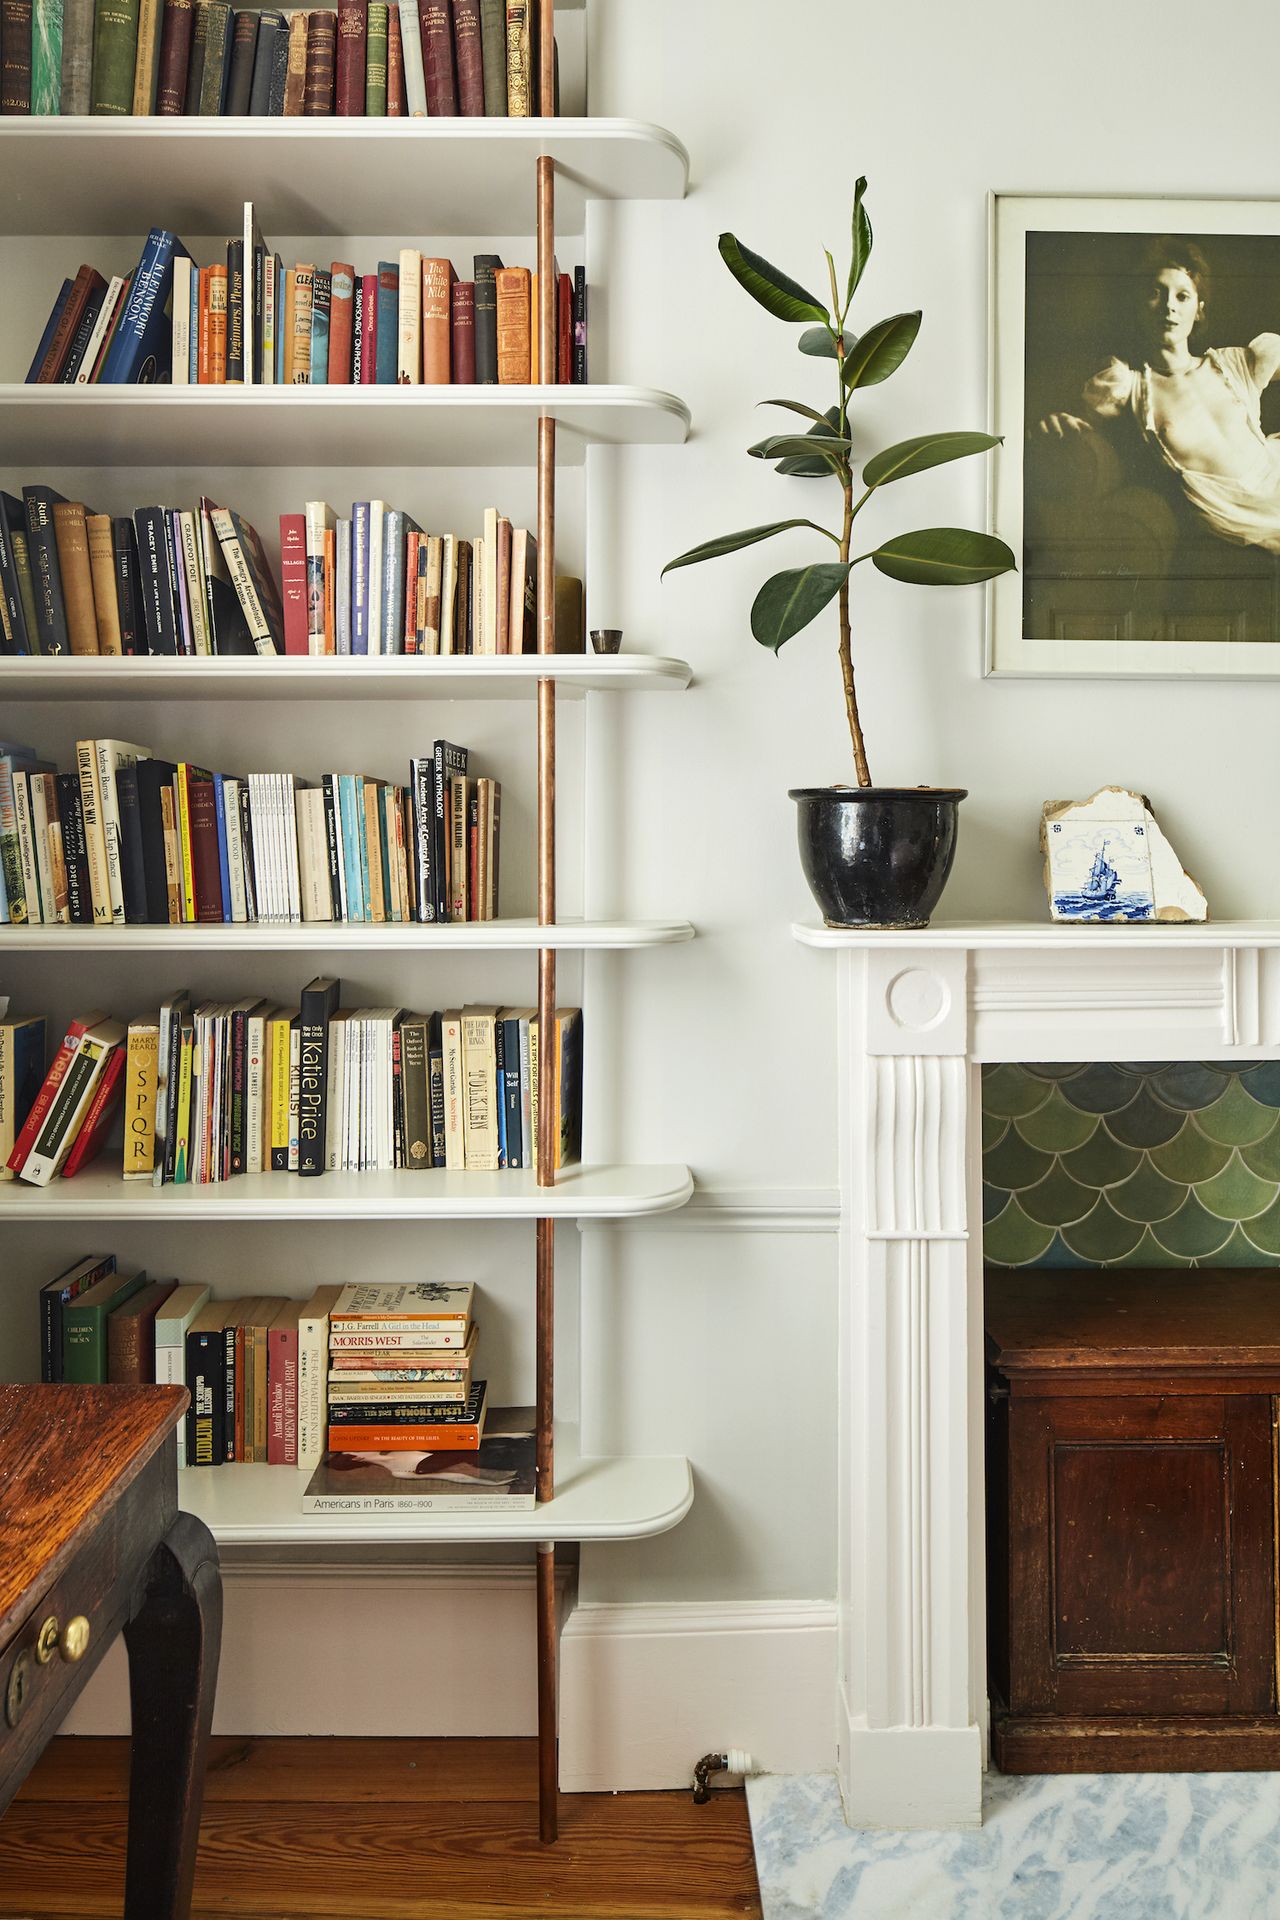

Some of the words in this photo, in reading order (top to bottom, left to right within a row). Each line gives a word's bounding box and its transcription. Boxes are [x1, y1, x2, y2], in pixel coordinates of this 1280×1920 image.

[428, 262, 444, 274] The
[230, 271, 242, 304] Please
[424, 274, 448, 287] White
[128, 271, 151, 323] BENSON
[134, 263, 165, 339] KLEINWORT
[355, 288, 363, 309] SUSAN
[427, 286, 446, 299] Nile
[229, 305, 242, 361] Beginners,
[355, 309, 363, 335] SONTAG
[354, 338, 362, 350] ON
[27, 496, 40, 533] Rendell
[38, 502, 47, 526] Ruth
[146, 520, 155, 551] TRACEY
[153, 579, 158, 587] MY
[183, 523, 194, 562] CRACKPOT
[231, 546, 241, 559] The
[37, 553, 49, 572] Sight
[120, 555, 128, 577] TERRY
[188, 563, 196, 583] POET
[234, 559, 249, 584] Hungry
[42, 574, 50, 587] For
[43, 589, 52, 606] Sore
[234, 581, 247, 606] France
[44, 608, 54, 625] Eyes
[191, 597, 201, 623] JEREMY
[243, 583, 265, 628] Archaeologist
[194, 624, 204, 647] SIGLER
[77, 746, 91, 769] LOOK
[97, 745, 109, 774] Andrew
[434, 746, 442, 771] GREEK
[80, 769, 92, 779] AT
[82, 780, 93, 788] IT
[82, 789, 96, 807] THIS
[100, 775, 112, 800] Barrow
[227, 785, 235, 811] UNDER
[419, 776, 428, 804] Ancient
[435, 773, 443, 818] MYTHOLOGY
[453, 783, 462, 811] MAKING
[84, 808, 97, 825] WAY
[420, 807, 428, 822] Arts
[105, 819, 115, 836] The
[420, 824, 429, 833] of
[454, 821, 463, 847] KILLING
[21, 835, 31, 867] intelligent
[78, 833, 86, 855] Robert
[105, 836, 117, 851] Tap
[421, 833, 429, 861] Central
[69, 864, 79, 887] place
[108, 852, 119, 878] Dancer
[422, 862, 430, 878] Asia
[71, 890, 79, 908] safe
[311, 1025, 324, 1033] Only
[464, 1021, 475, 1029] THE
[467, 1029, 474, 1037] OF
[475, 1029, 486, 1037] THE
[449, 1048, 456, 1057] My
[468, 1037, 485, 1046] RINGS
[47, 1050, 73, 1088] heat
[78, 1059, 89, 1074] DEATH
[302, 1042, 323, 1089] Katie
[449, 1056, 457, 1075] Secret
[69, 1079, 79, 1096] CREDIT
[291, 1064, 300, 1092] KILL
[506, 1079, 519, 1087] Self
[522, 1069, 530, 1090] carver
[38, 1095, 48, 1107] Bill
[290, 1092, 300, 1116] LIST
[469, 1069, 489, 1131] TOLKIEN
[27, 1106, 44, 1131] Buford
[301, 1094, 322, 1140] Price
[449, 1114, 457, 1132] Friday
[341, 1323, 356, 1331] J.G.
[357, 1322, 379, 1330] Farrell
[388, 1322, 402, 1330] Girl
[402, 1322, 408, 1330] in
[408, 1322, 421, 1330] the
[422, 1322, 440, 1330] Head
[333, 1337, 374, 1347] MORRIS
[374, 1336, 403, 1346] WEST
[226, 1369, 234, 1383] HOLY
[284, 1359, 295, 1386] ARBAT
[196, 1375, 205, 1403] SCORPIO
[310, 1349, 319, 1420] PRE-RAPHAELITES
[204, 1387, 213, 1414] ILLUSION
[226, 1383, 234, 1413] PICTURES
[271, 1382, 283, 1411] Rybakov
[284, 1388, 295, 1405] THE
[196, 1403, 204, 1415] THE
[284, 1407, 295, 1417] OF
[394, 1408, 433, 1417] THOMAS
[434, 1407, 462, 1415] LESLIE
[272, 1412, 283, 1438] Anatoli
[310, 1421, 318, 1431] IN
[196, 1418, 213, 1463] LUDLUM
[284, 1418, 295, 1461] CHILDREN
[310, 1432, 318, 1455] LOVE
[314, 1499, 361, 1509] Americans
[363, 1499, 372, 1509] in
[374, 1499, 394, 1509] Paris
